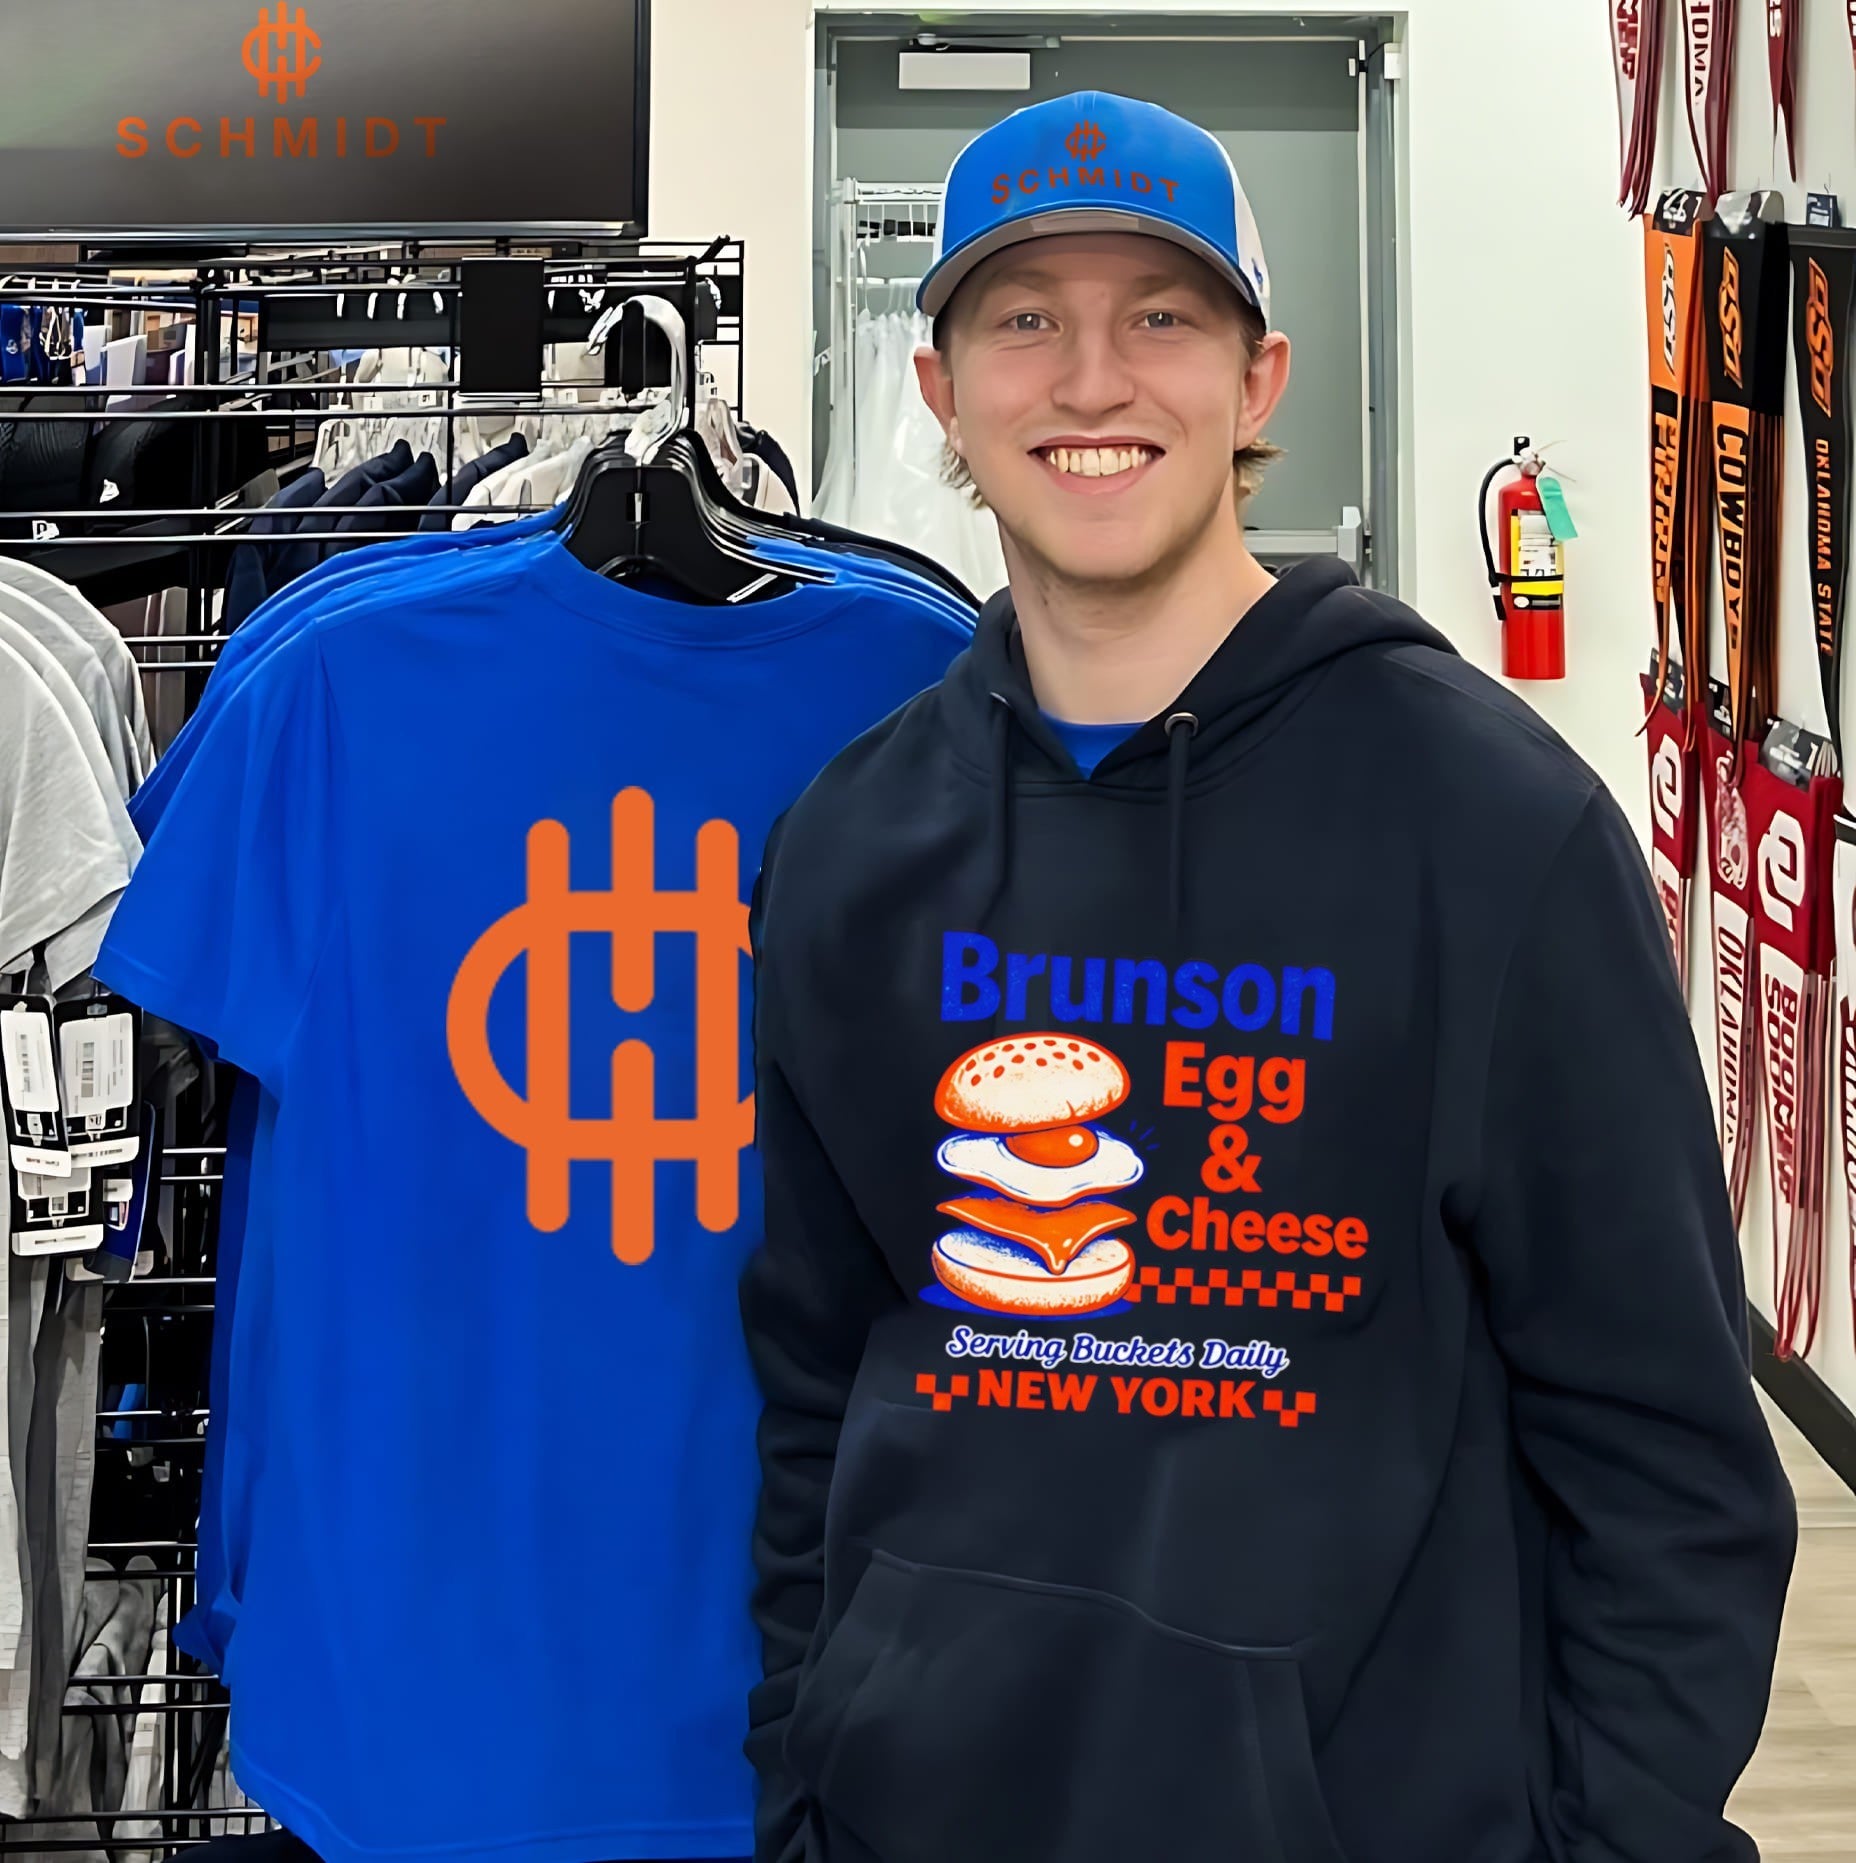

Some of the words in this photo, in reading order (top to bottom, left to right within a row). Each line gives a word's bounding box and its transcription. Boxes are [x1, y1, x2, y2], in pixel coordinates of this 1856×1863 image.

[116, 117, 448, 158] SCHMIDT
[991, 166, 1180, 204] SCHMIDT
[1815, 438, 1833, 571] OKLAHOMA
[940, 930, 1336, 1041] Brunson
[1163, 1040, 1306, 1124] Egg
[1200, 1123, 1262, 1194] &
[1146, 1195, 1369, 1259] Cheese
[947, 1325, 1067, 1369] Serving
[1070, 1332, 1195, 1367] Buckets
[1199, 1338, 1290, 1378] Daily
[977, 1369, 1098, 1412] NEW
[1110, 1376, 1257, 1418] YORK
